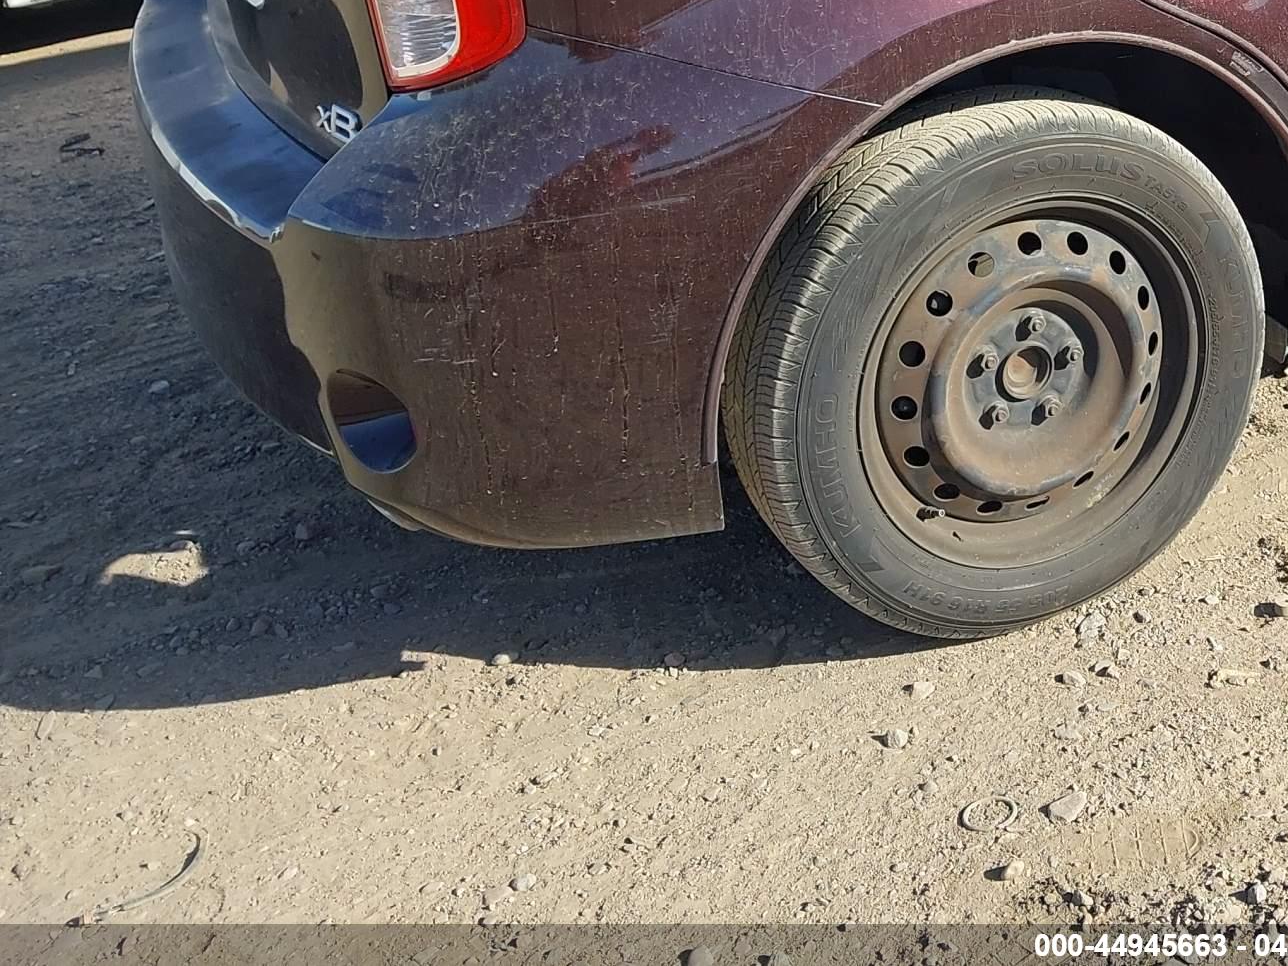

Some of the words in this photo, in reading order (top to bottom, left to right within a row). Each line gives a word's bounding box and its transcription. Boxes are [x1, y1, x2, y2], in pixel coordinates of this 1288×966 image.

[316, 103, 360, 143] xB
[1011, 152, 1145, 182] SOLUS
[813, 392, 864, 538] KUMHO
